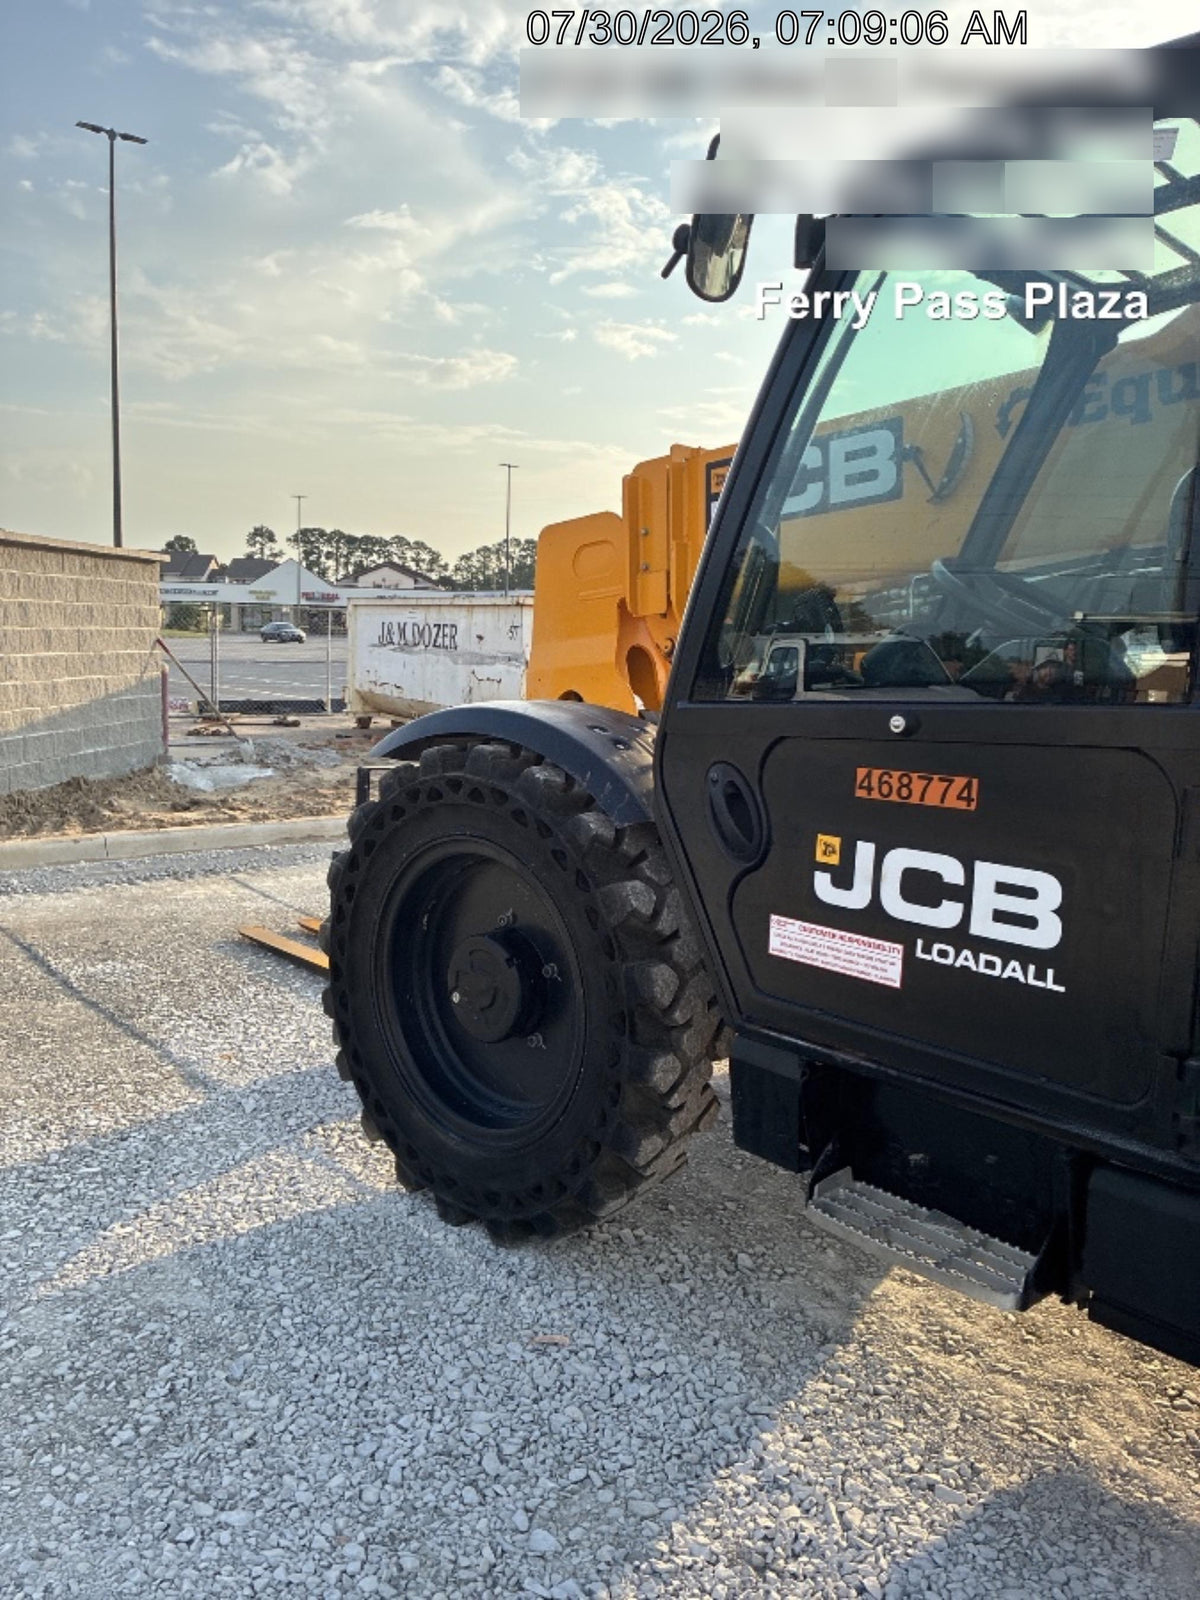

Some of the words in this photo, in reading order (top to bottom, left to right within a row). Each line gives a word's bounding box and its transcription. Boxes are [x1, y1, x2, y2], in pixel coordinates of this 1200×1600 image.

[411, 621, 458, 651] DOZER
[857, 768, 975, 808] 468774
[813, 838, 1063, 950] JCB
[914, 937, 1066, 993] LOADALL
